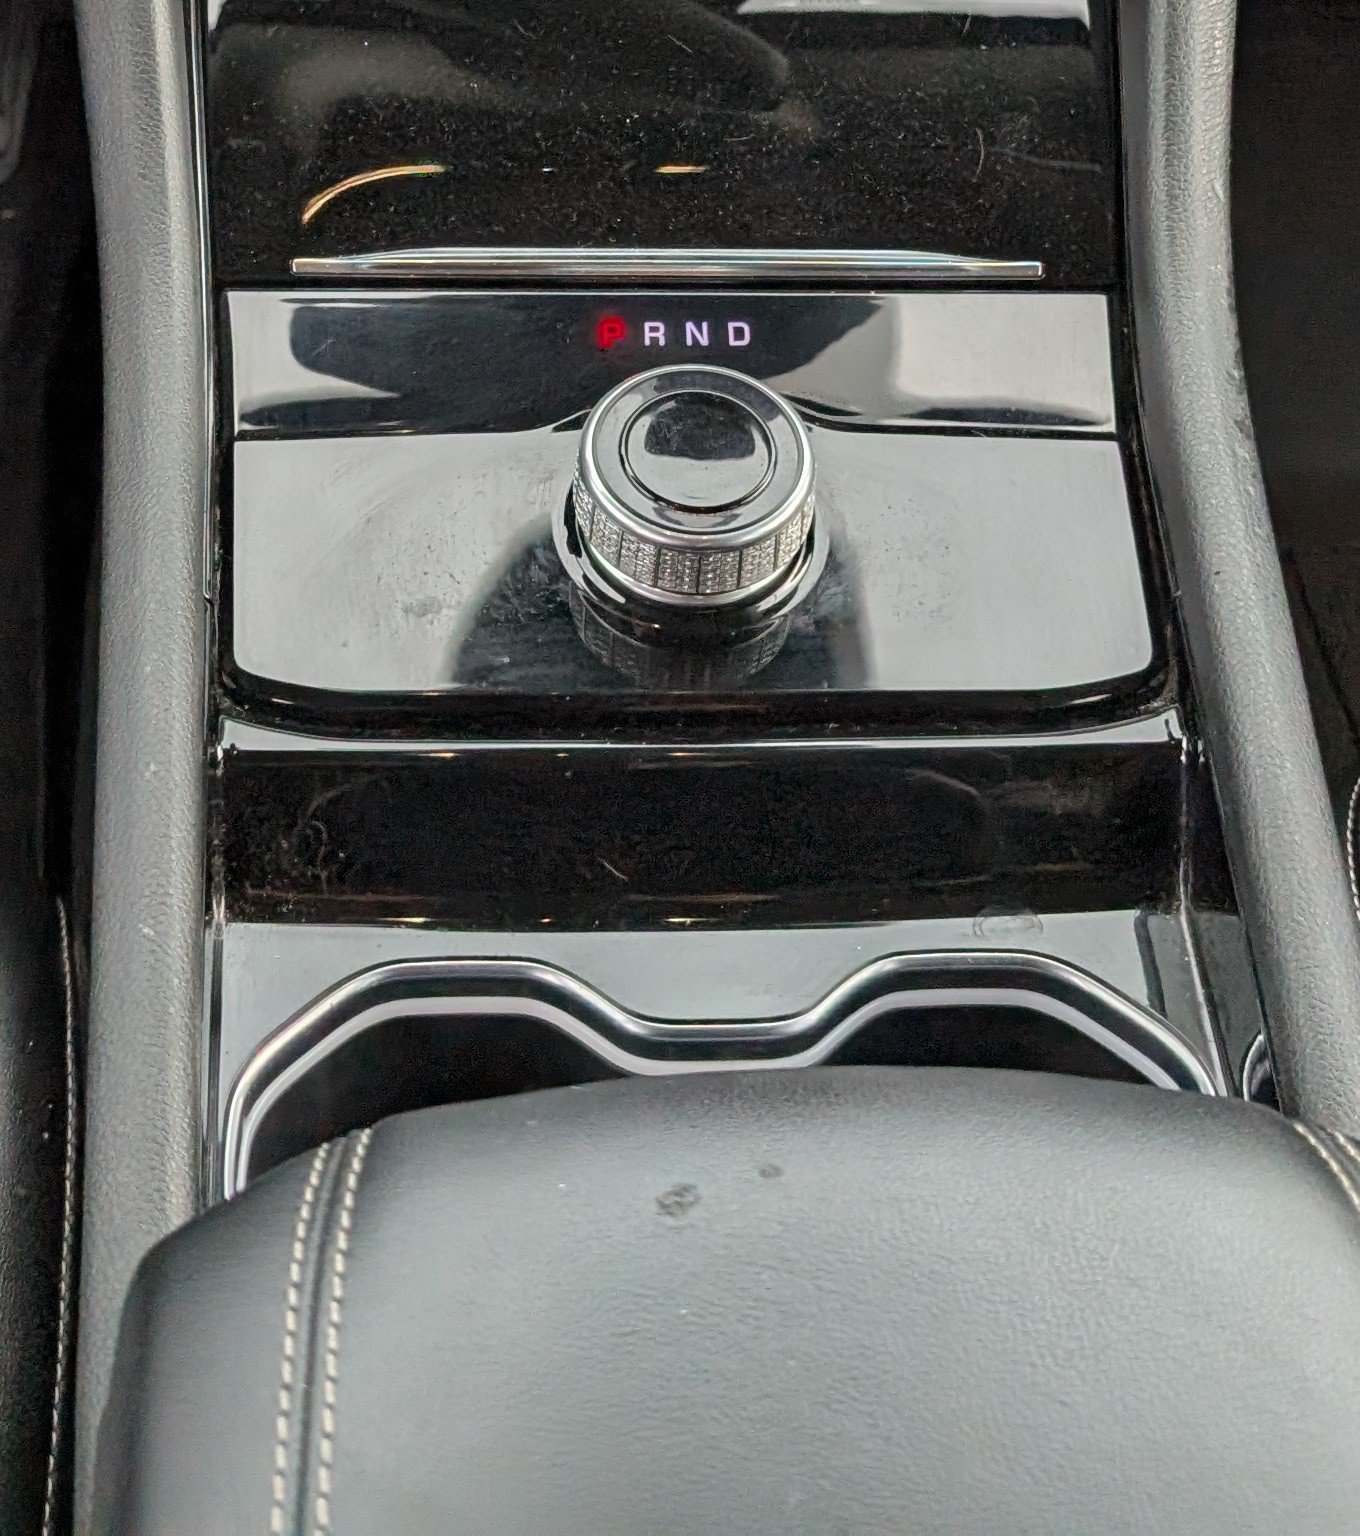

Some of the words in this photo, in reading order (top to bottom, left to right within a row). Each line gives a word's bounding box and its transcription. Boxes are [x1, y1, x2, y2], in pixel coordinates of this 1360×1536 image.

[600, 318, 625, 350] P
[643, 321, 666, 347] R
[685, 321, 709, 347] N
[727, 321, 751, 347] D
